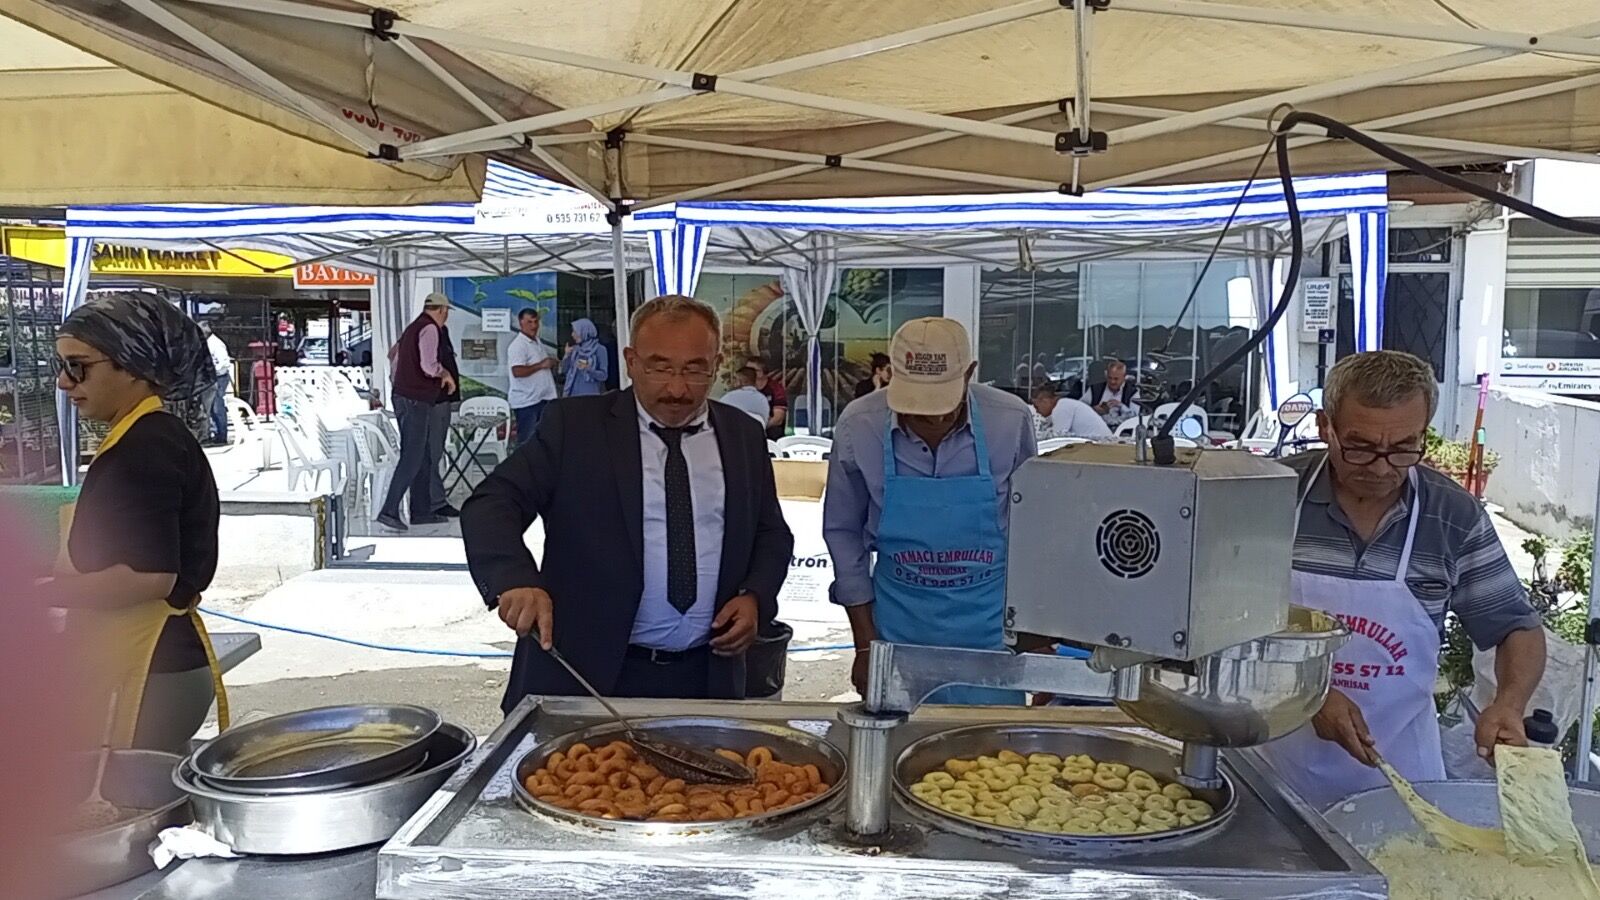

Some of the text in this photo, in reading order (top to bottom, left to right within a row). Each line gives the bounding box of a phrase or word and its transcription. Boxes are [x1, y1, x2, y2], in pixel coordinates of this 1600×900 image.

[937, 549, 994, 565] EMRULLAH
[1360, 664, 1381, 678] 57
[1386, 665, 1405, 677] 12
